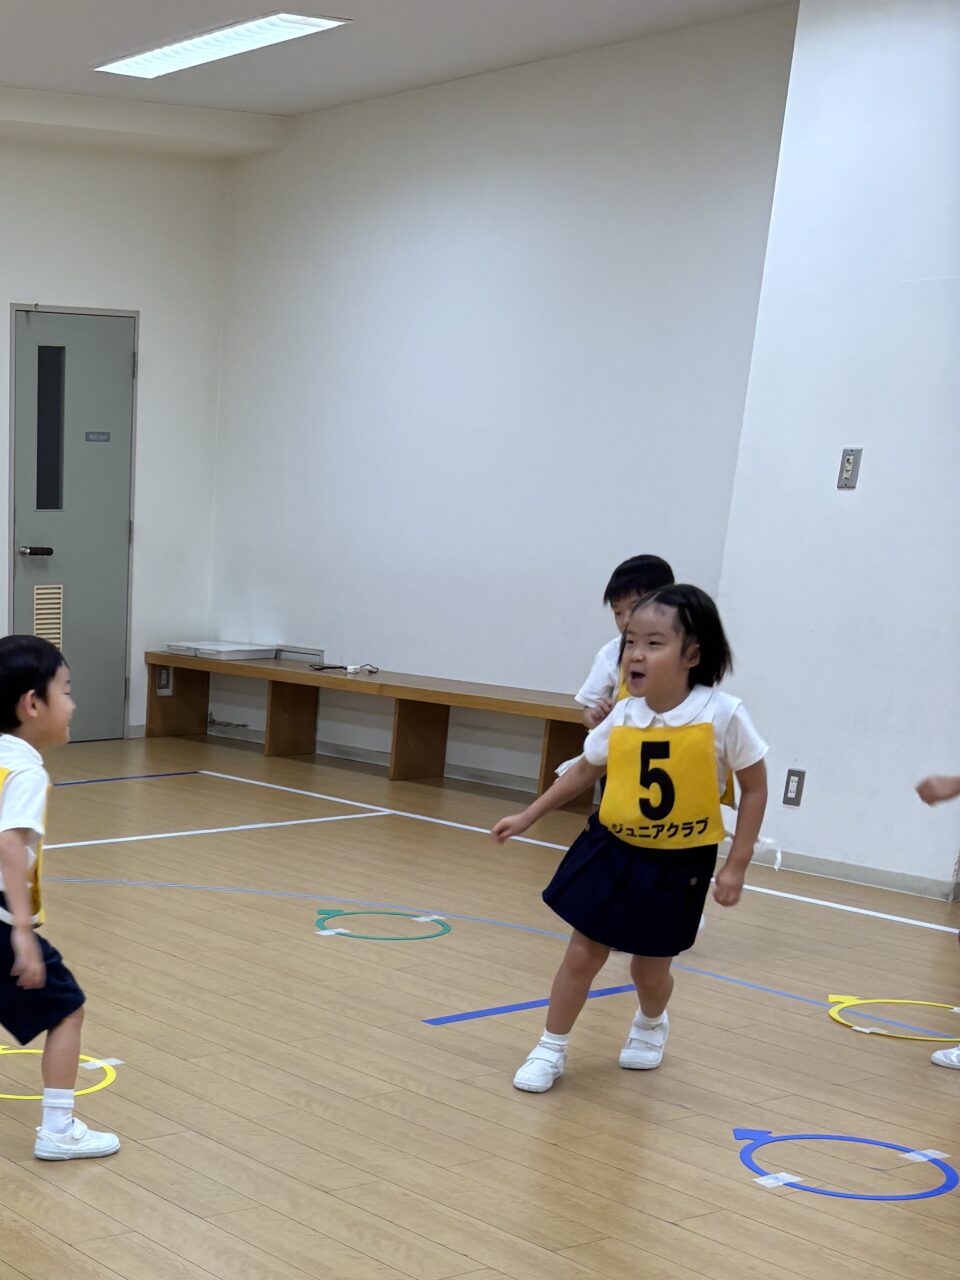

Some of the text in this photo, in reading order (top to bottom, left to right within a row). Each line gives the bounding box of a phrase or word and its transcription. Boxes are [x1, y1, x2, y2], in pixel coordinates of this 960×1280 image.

[638, 740, 675, 821] 5
[611, 816, 709, 839] ジュニアクラブ
